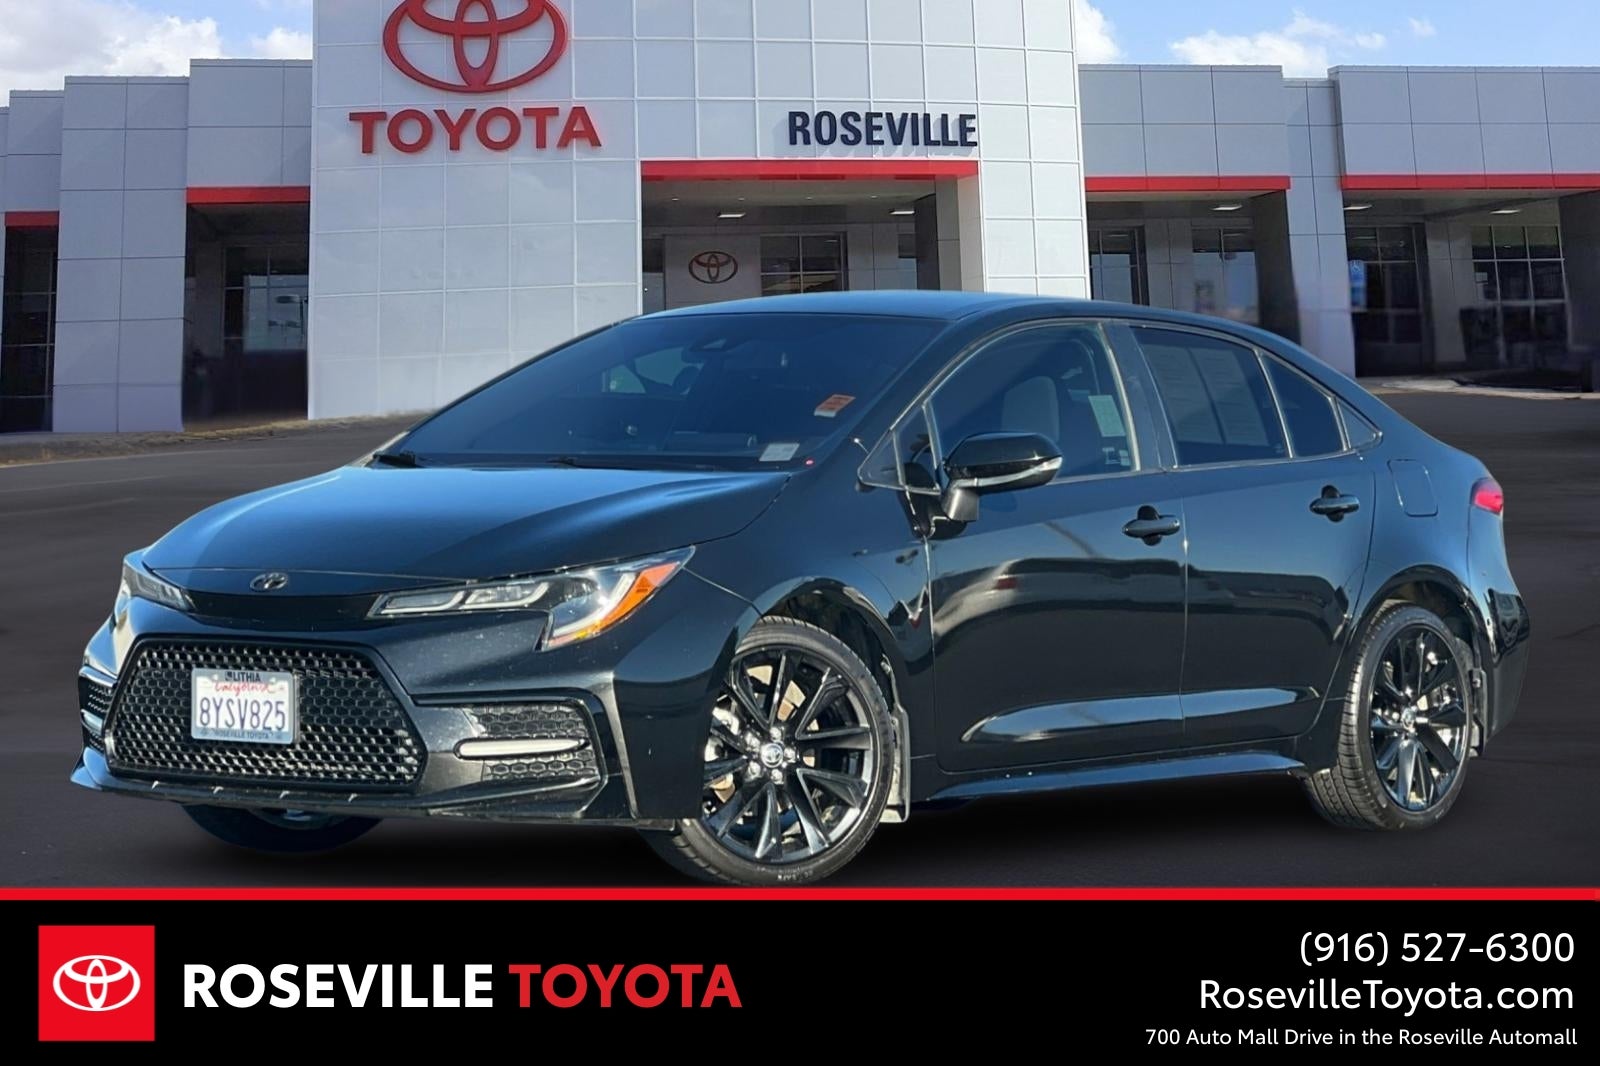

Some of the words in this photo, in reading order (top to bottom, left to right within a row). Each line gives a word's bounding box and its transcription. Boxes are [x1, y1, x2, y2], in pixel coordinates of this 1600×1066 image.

[350, 106, 602, 154] TOYOTA
[788, 110, 978, 147] ROSEVILLE
[233, 671, 261, 682] LITHIA
[199, 696, 286, 731] 8YSV825
